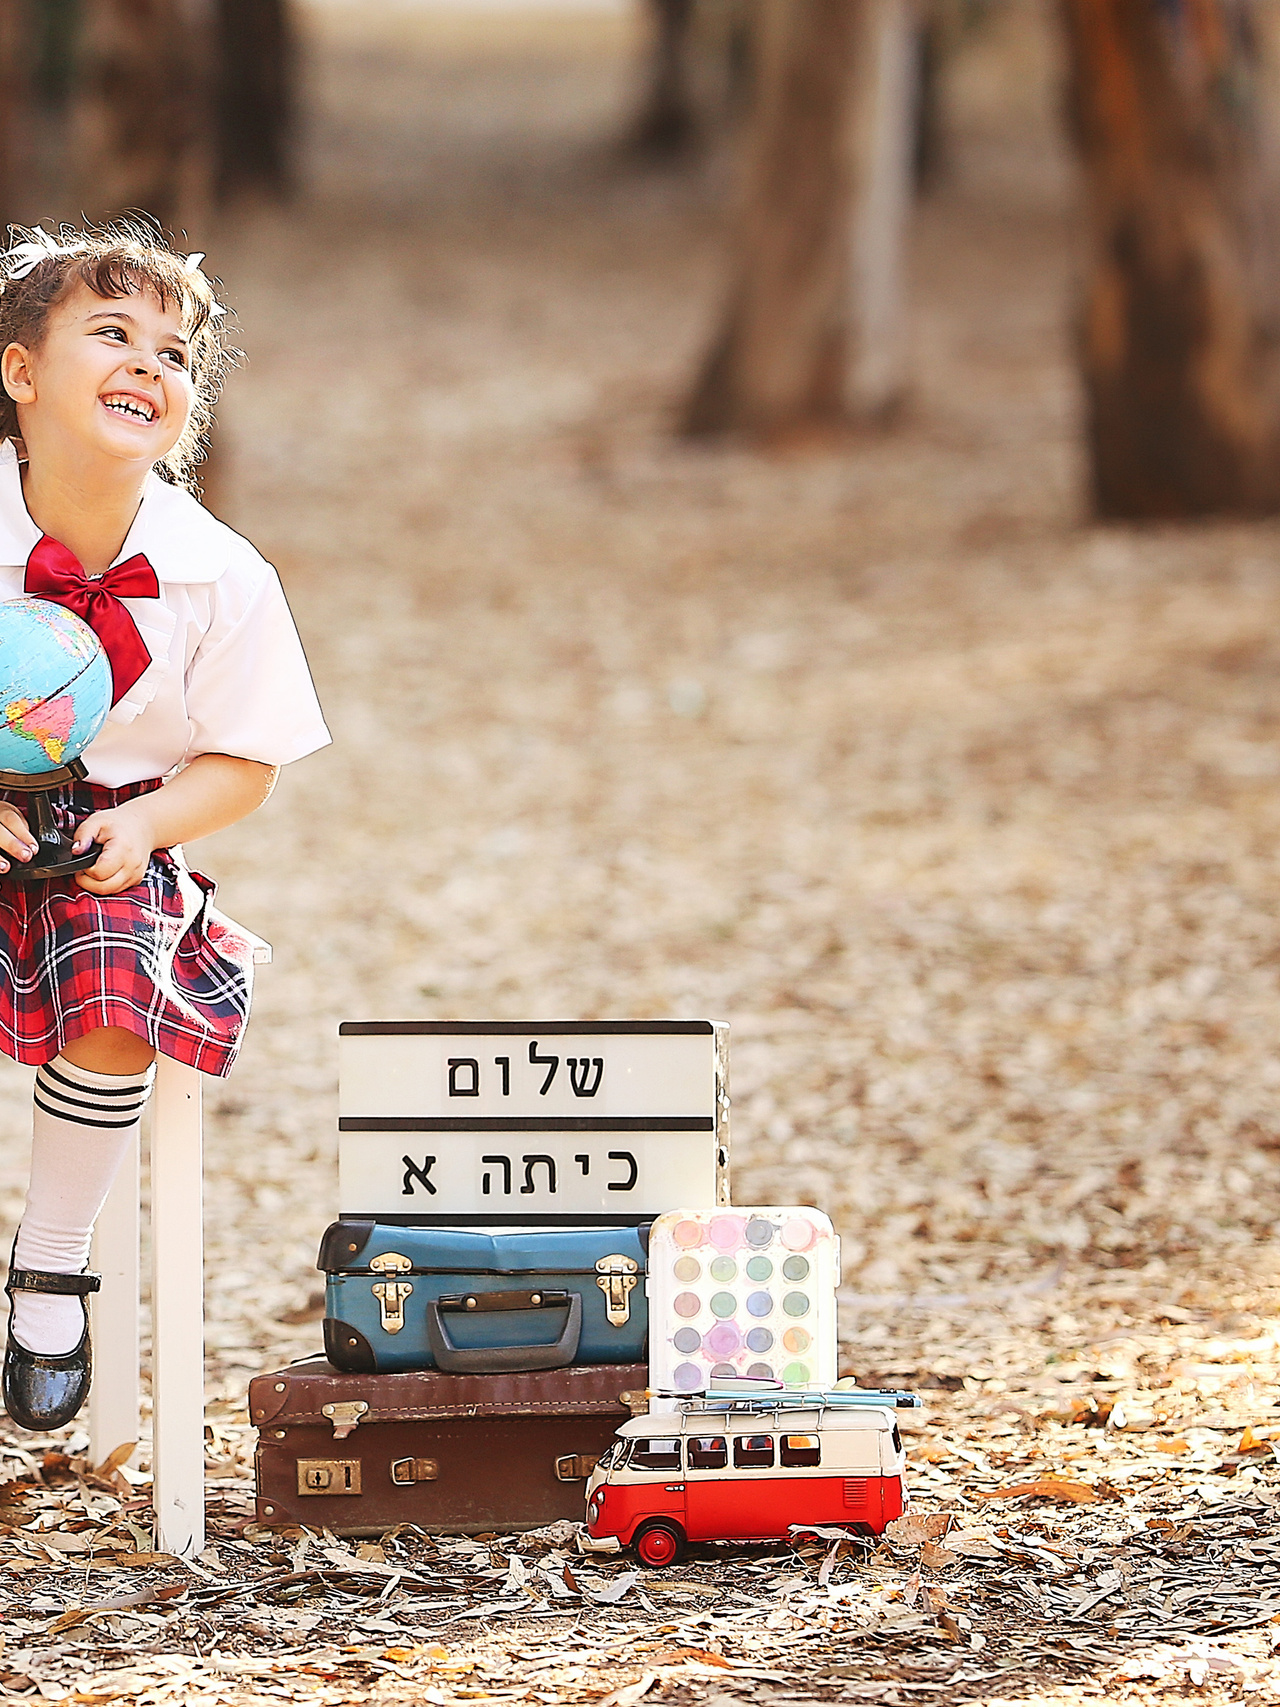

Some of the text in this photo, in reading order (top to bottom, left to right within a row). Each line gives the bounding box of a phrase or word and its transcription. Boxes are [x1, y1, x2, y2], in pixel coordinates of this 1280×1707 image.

[448, 1041, 603, 1097] שלום
[402, 1152, 637, 1195] כיתה א
